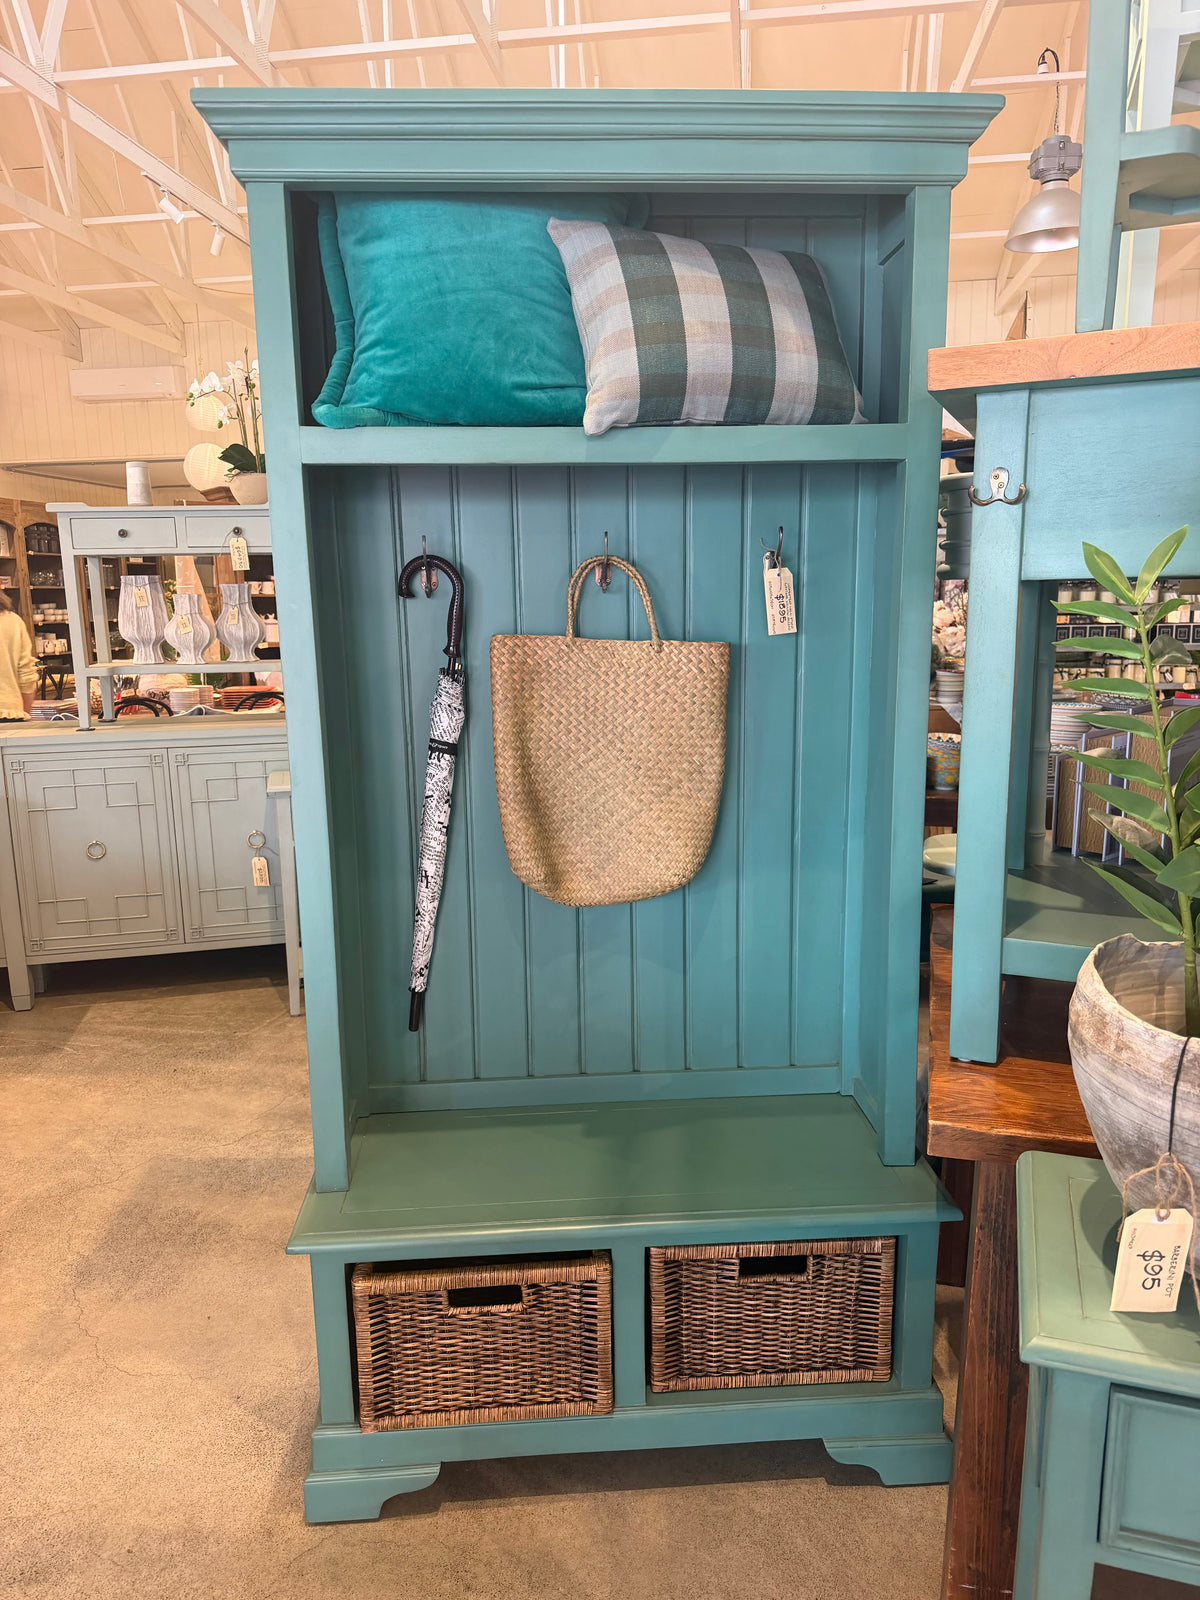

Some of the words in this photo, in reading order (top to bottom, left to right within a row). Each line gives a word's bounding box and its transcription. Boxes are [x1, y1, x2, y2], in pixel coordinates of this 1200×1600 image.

[1136, 1250, 1166, 1291] $95
[1166, 1245, 1181, 1281] BARBERINI
[1165, 1283, 1174, 1298] POT
